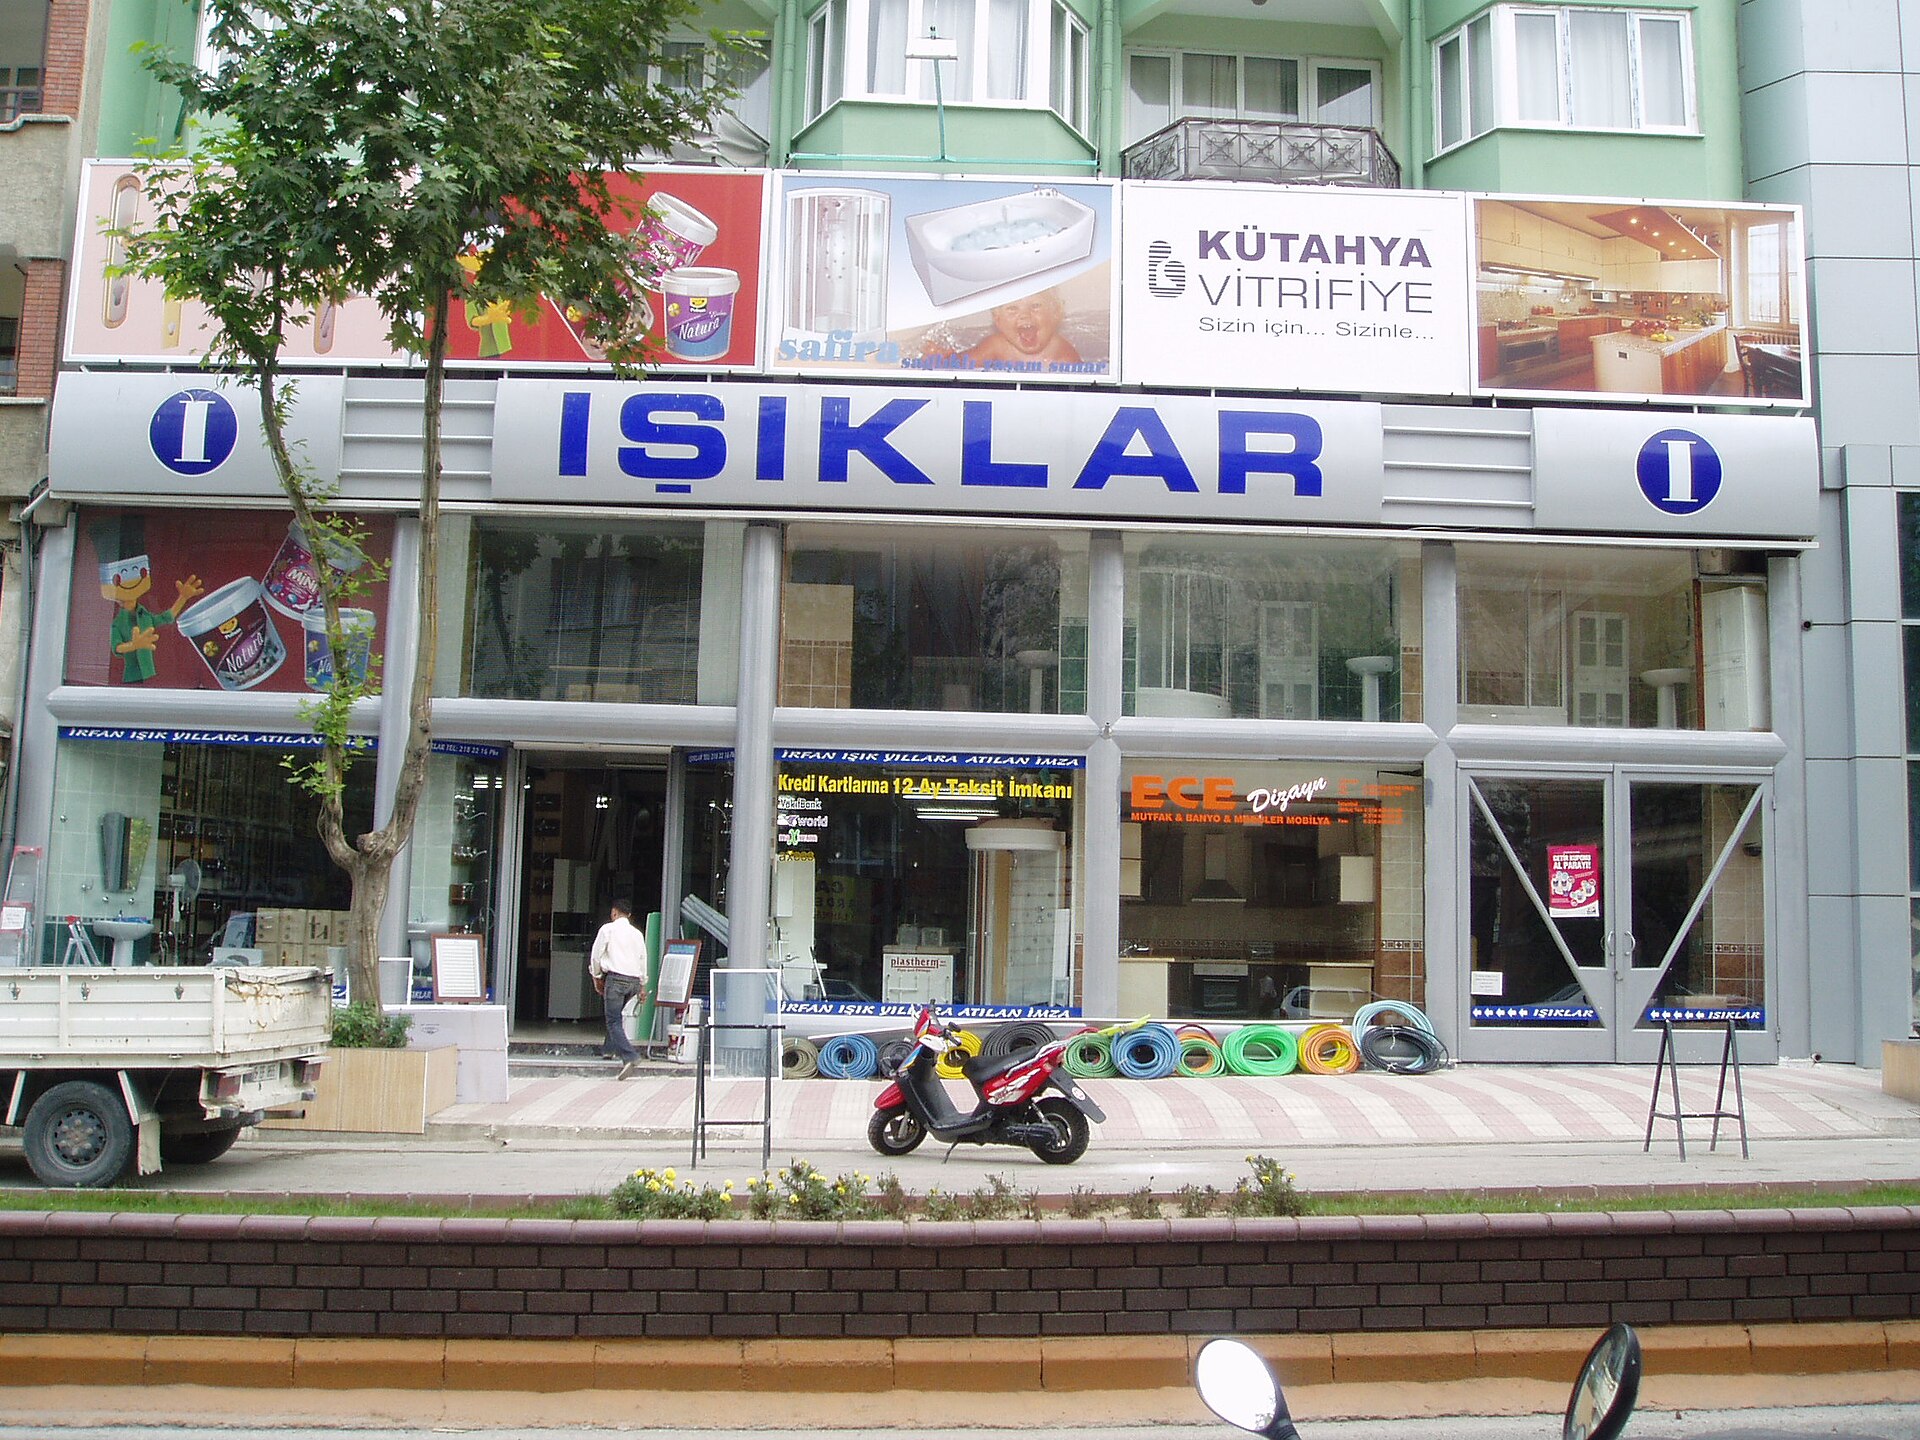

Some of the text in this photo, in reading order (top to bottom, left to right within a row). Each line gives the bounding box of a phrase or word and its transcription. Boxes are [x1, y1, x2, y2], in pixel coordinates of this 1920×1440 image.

[1199, 225, 1432, 268] KÜTAHYA
[1199, 268, 1432, 313] VİTRİFİYE
[679, 317, 720, 340] Natura
[1199, 317, 1434, 340] Sizin için... Sizinle...
[778, 329, 901, 363] safira
[559, 392, 1323, 497] IŞIKLAR
[226, 632, 264, 672] Natura
[69, 727, 323, 744] İRFAN IŞIK YILLARA ATILAN
[781, 750, 1079, 766] İRFAN IŞIK YILLARA ATILAN İMZA
[778, 774, 1073, 799] Kredi Kartlarına 12 Ay Taksit İmkanı
[1131, 775, 1237, 811] ECE
[1247, 776, 1327, 813] Dizayn
[797, 816, 828, 827] world
[1131, 812, 1172, 822] MUTFAK
[1175, 813, 1183, 822] &
[1186, 814, 1220, 824] BANYO
[1223, 815, 1231, 823] &
[1287, 814, 1332, 826] MOBİLYA
[891, 957, 939, 968] plastherm
[781, 1001, 833, 1013] İRFAN
[838, 1004, 875, 1015] IŞIK
[958, 1008, 1022, 1018] ATILAN
[1027, 1007, 1070, 1018] İMZA
[1533, 1008, 1594, 1019] IŞIKLAR
